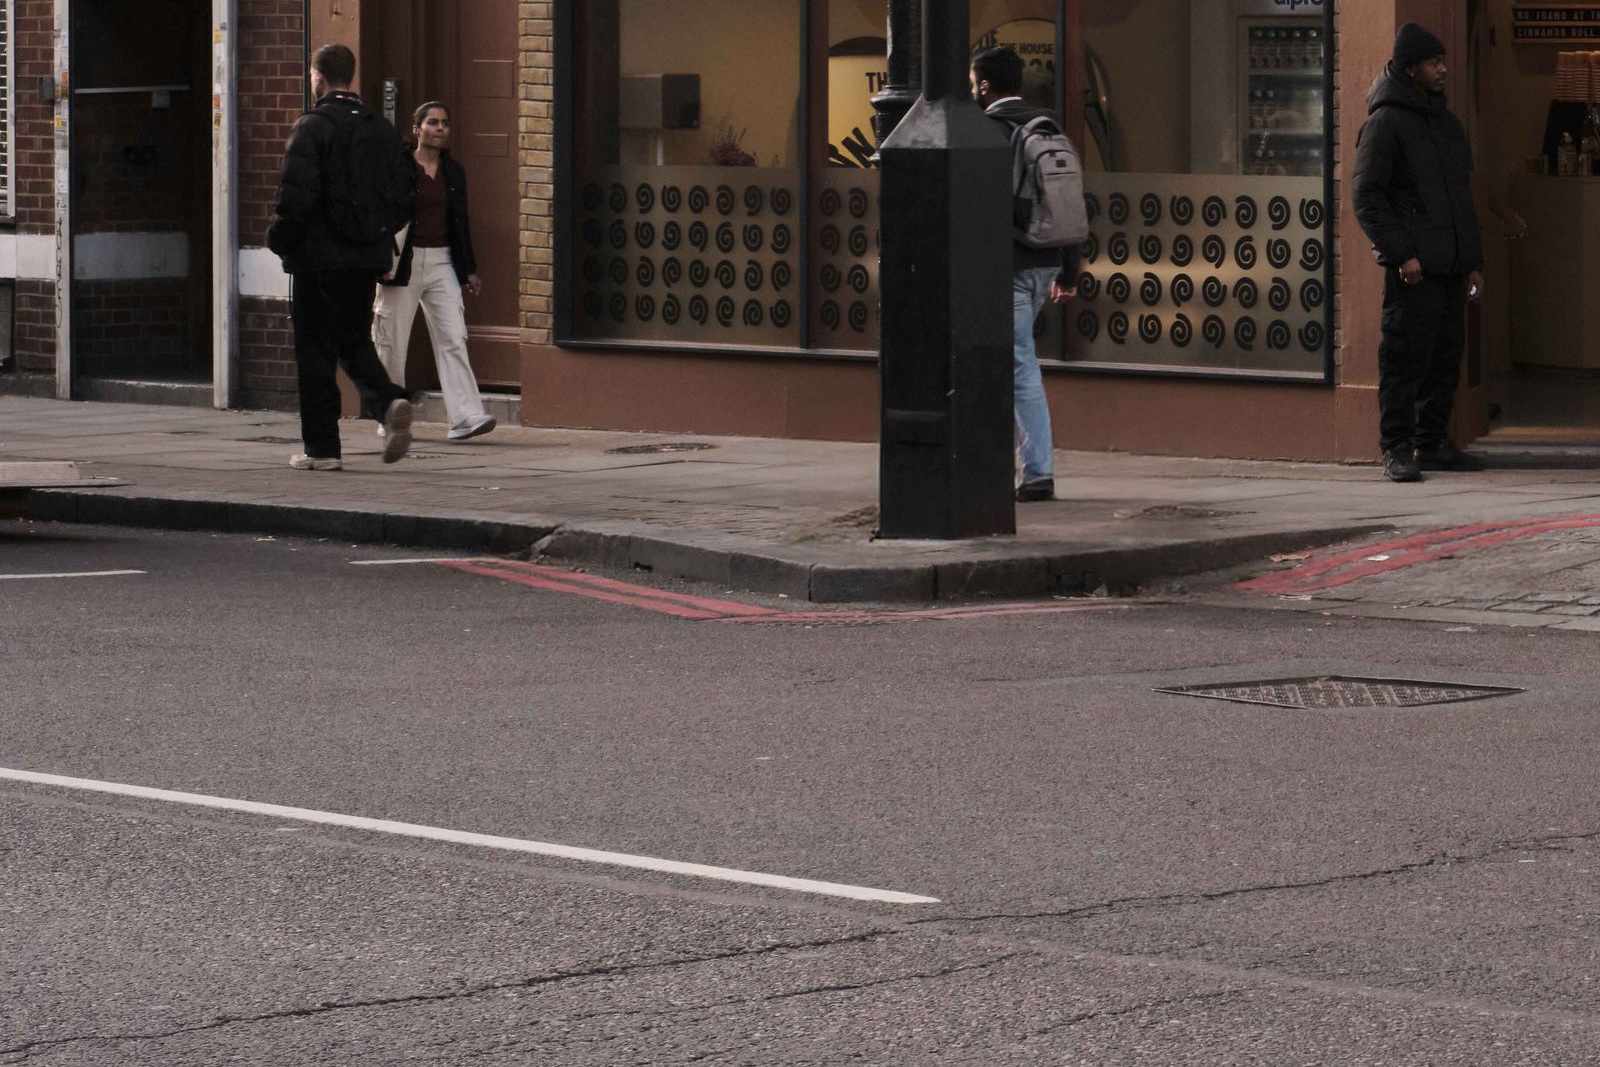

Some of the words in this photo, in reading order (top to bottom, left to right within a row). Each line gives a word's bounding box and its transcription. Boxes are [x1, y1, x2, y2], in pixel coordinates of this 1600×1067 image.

[1517, 28, 1566, 38] CINNAMON
[1019, 43, 1054, 55] HOUSE
[865, 72, 888, 92] TH
